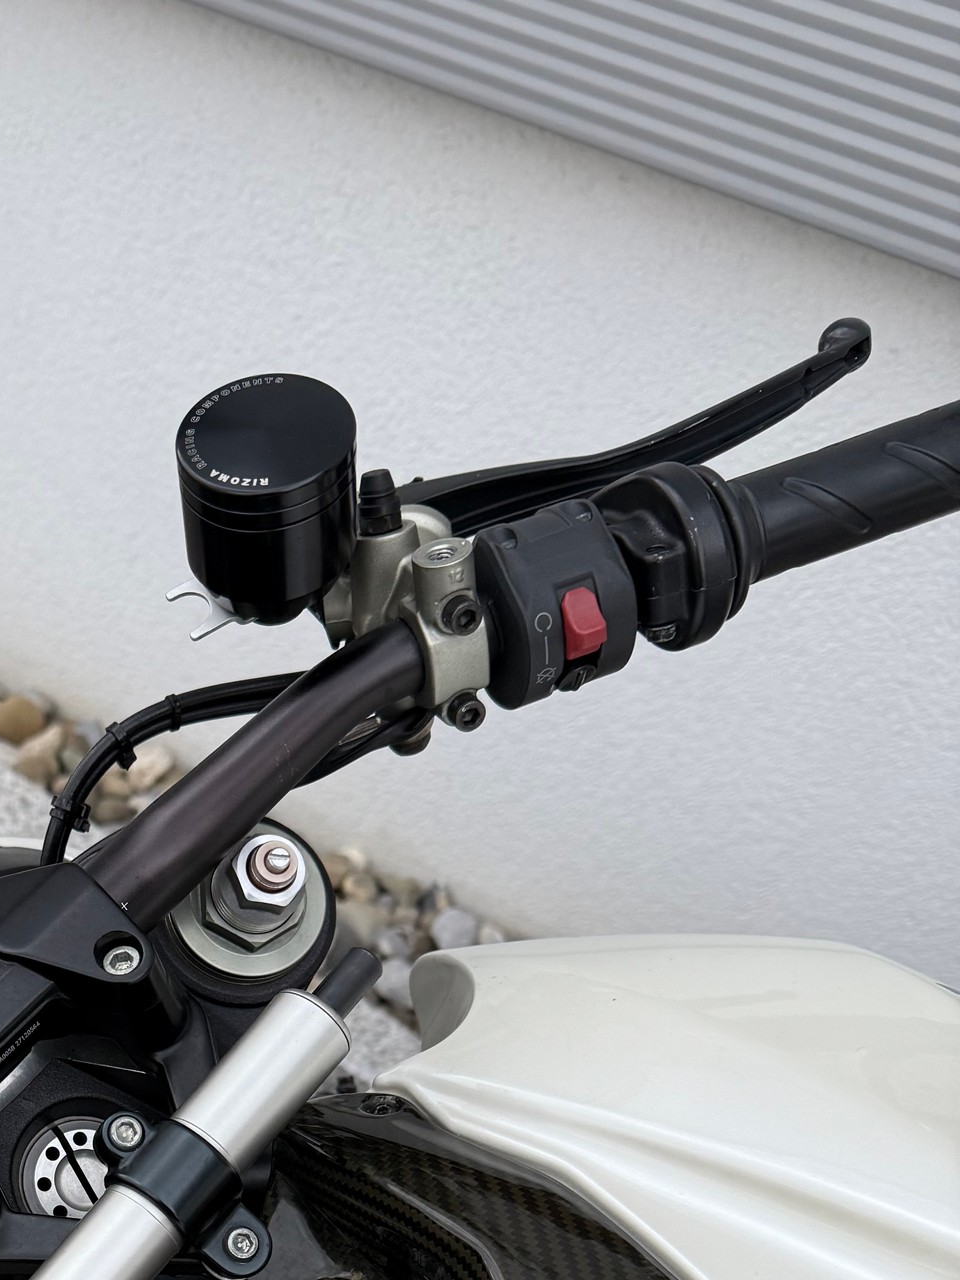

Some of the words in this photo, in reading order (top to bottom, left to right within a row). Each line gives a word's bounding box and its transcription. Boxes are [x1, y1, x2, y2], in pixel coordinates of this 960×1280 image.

[190, 376, 284, 423] COMPONENTS
[185, 428, 207, 470] RACING
[209, 468, 269, 486] RIZOMA
